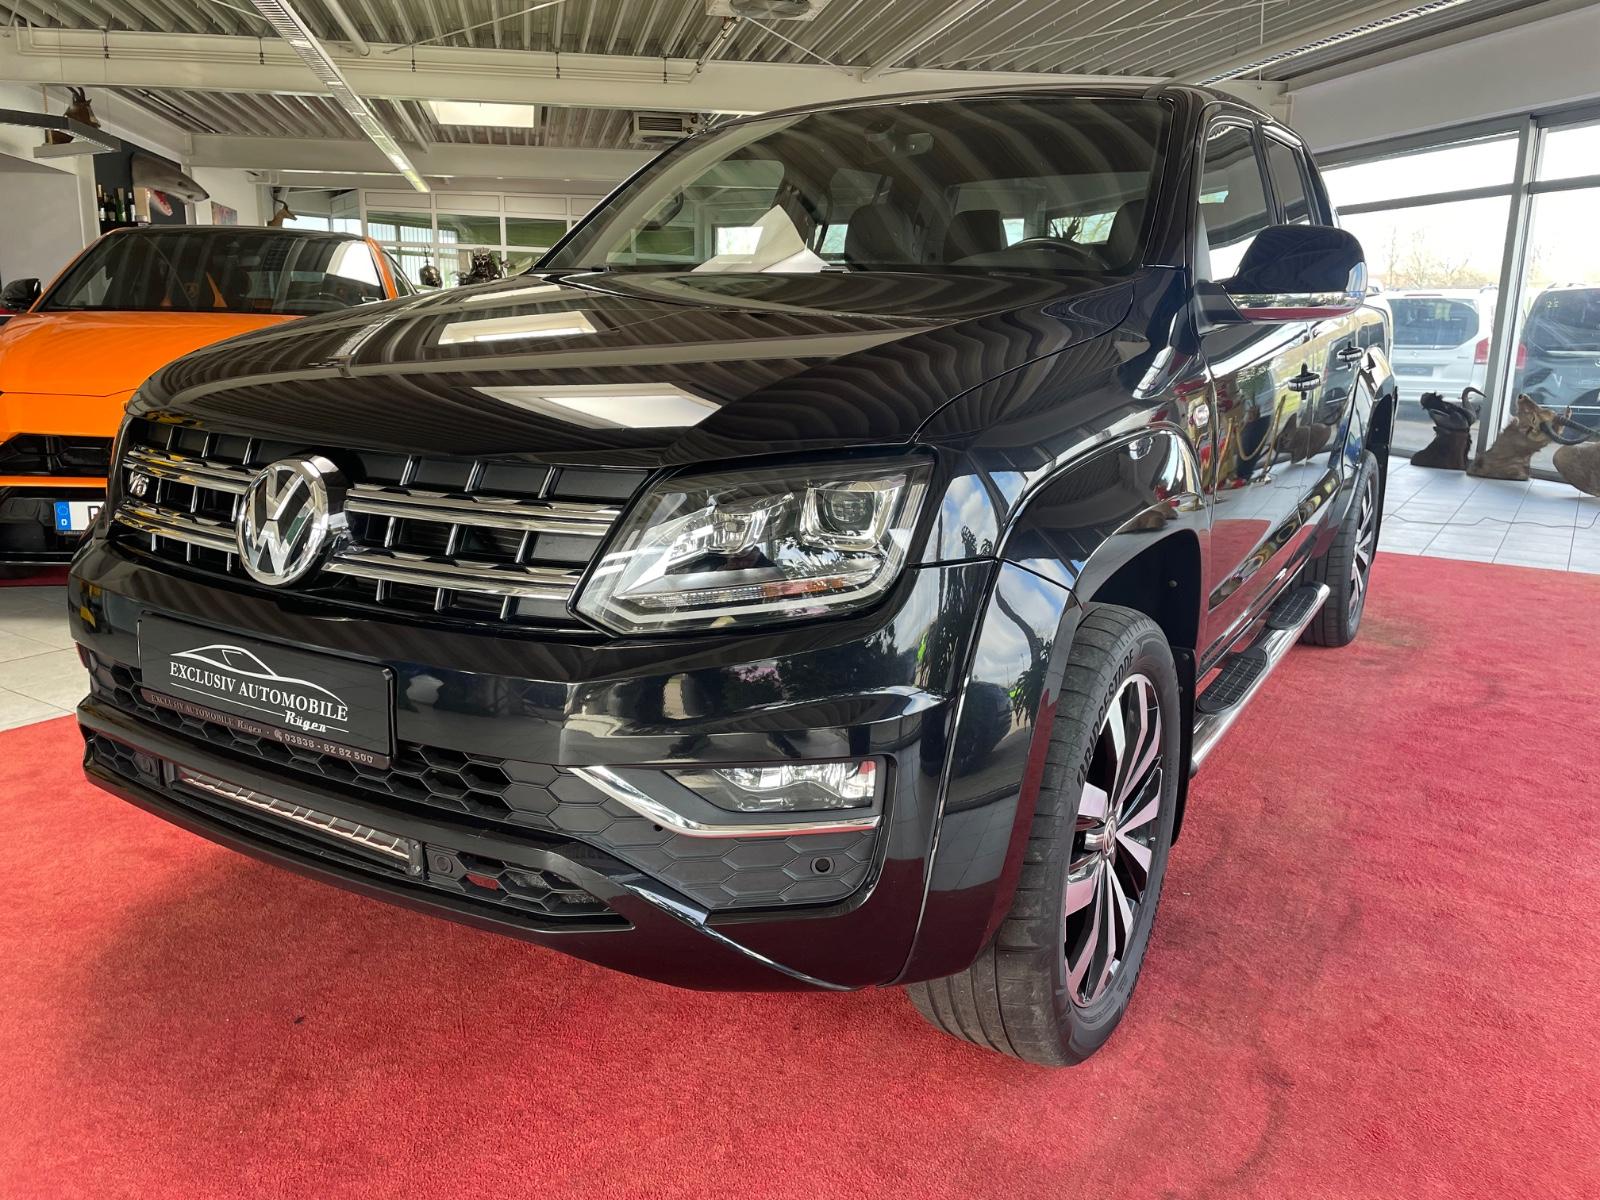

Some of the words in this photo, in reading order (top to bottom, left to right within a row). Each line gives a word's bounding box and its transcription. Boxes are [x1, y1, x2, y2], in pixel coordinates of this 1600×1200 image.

[129, 471, 149, 497] V6
[169, 661, 236, 692] EXCLUSIV
[238, 681, 348, 722] AUTOMOBILE
[150, 694, 184, 712] EXCLUSIV
[185, 705, 235, 726] AUTOMOBILE
[284, 733, 315, 749] 03838
[354, 752, 374, 764] 500
[284, 709, 327, 733] Rügen
